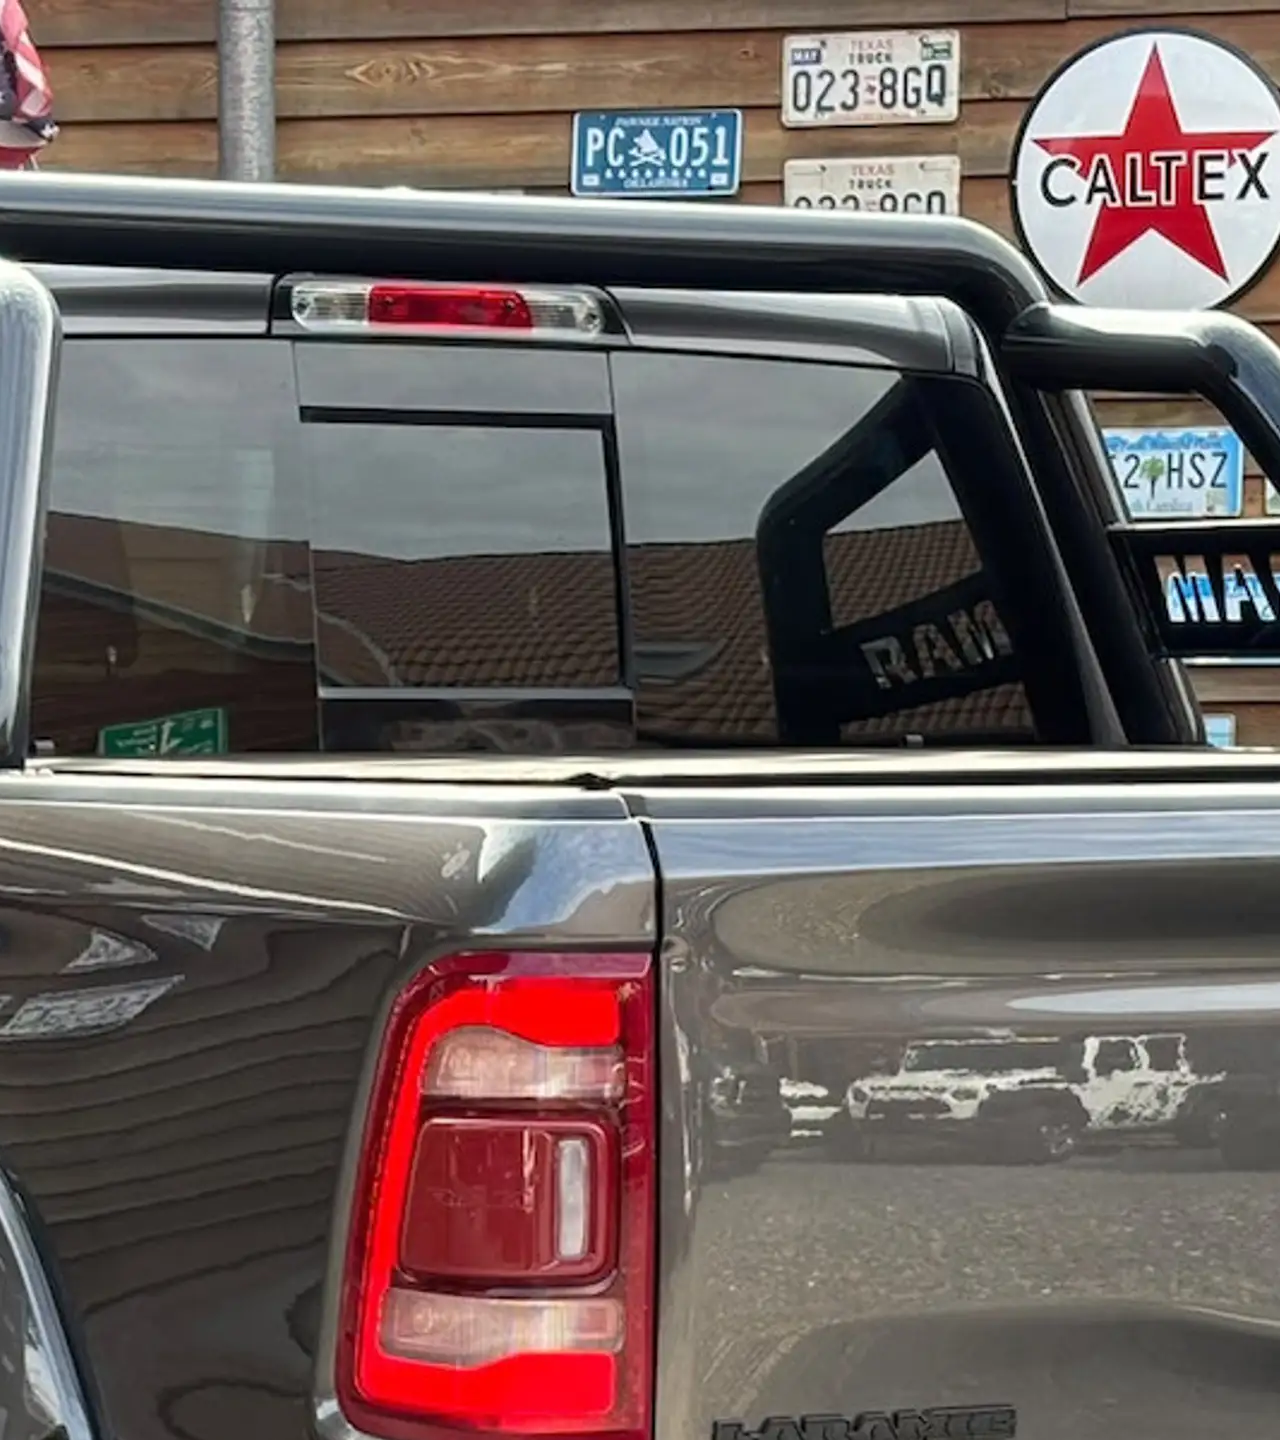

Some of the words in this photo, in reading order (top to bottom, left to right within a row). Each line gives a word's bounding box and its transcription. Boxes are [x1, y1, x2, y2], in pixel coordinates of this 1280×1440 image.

[848, 52, 893, 64] TRUCK
[850, 39, 894, 50] TEXAS
[1040, 152, 1270, 208] CALTEX
[859, 599, 1014, 689] RAM
